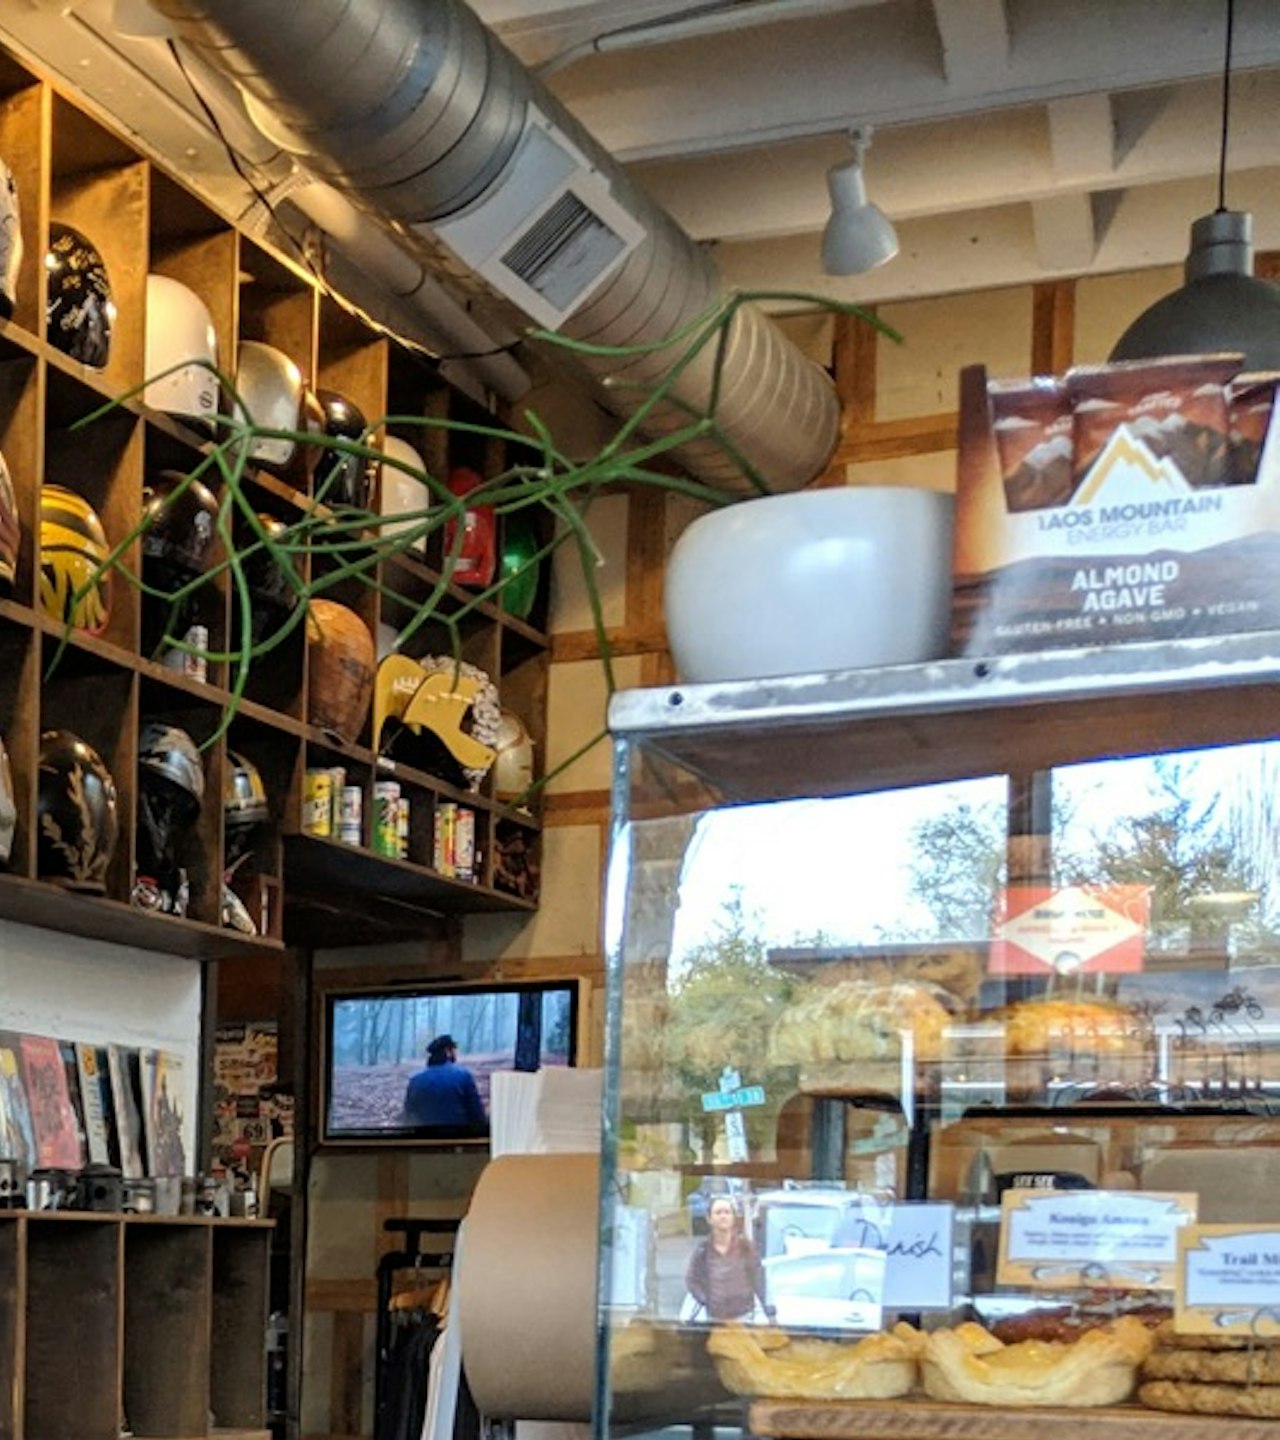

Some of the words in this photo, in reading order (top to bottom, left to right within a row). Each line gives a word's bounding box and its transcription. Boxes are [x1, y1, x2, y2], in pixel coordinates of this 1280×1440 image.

[1099, 494, 1222, 526] MOUNTAIN
[1066, 523, 1145, 547] ENERGY
[1147, 517, 1189, 535] BAR
[1071, 559, 1181, 592] ALMOND
[1082, 584, 1167, 613] AGAVE
[1112, 607, 1186, 627] NON-GMO
[1206, 600, 1259, 618] VEGAN
[1222, 1252, 1258, 1265] Trail
